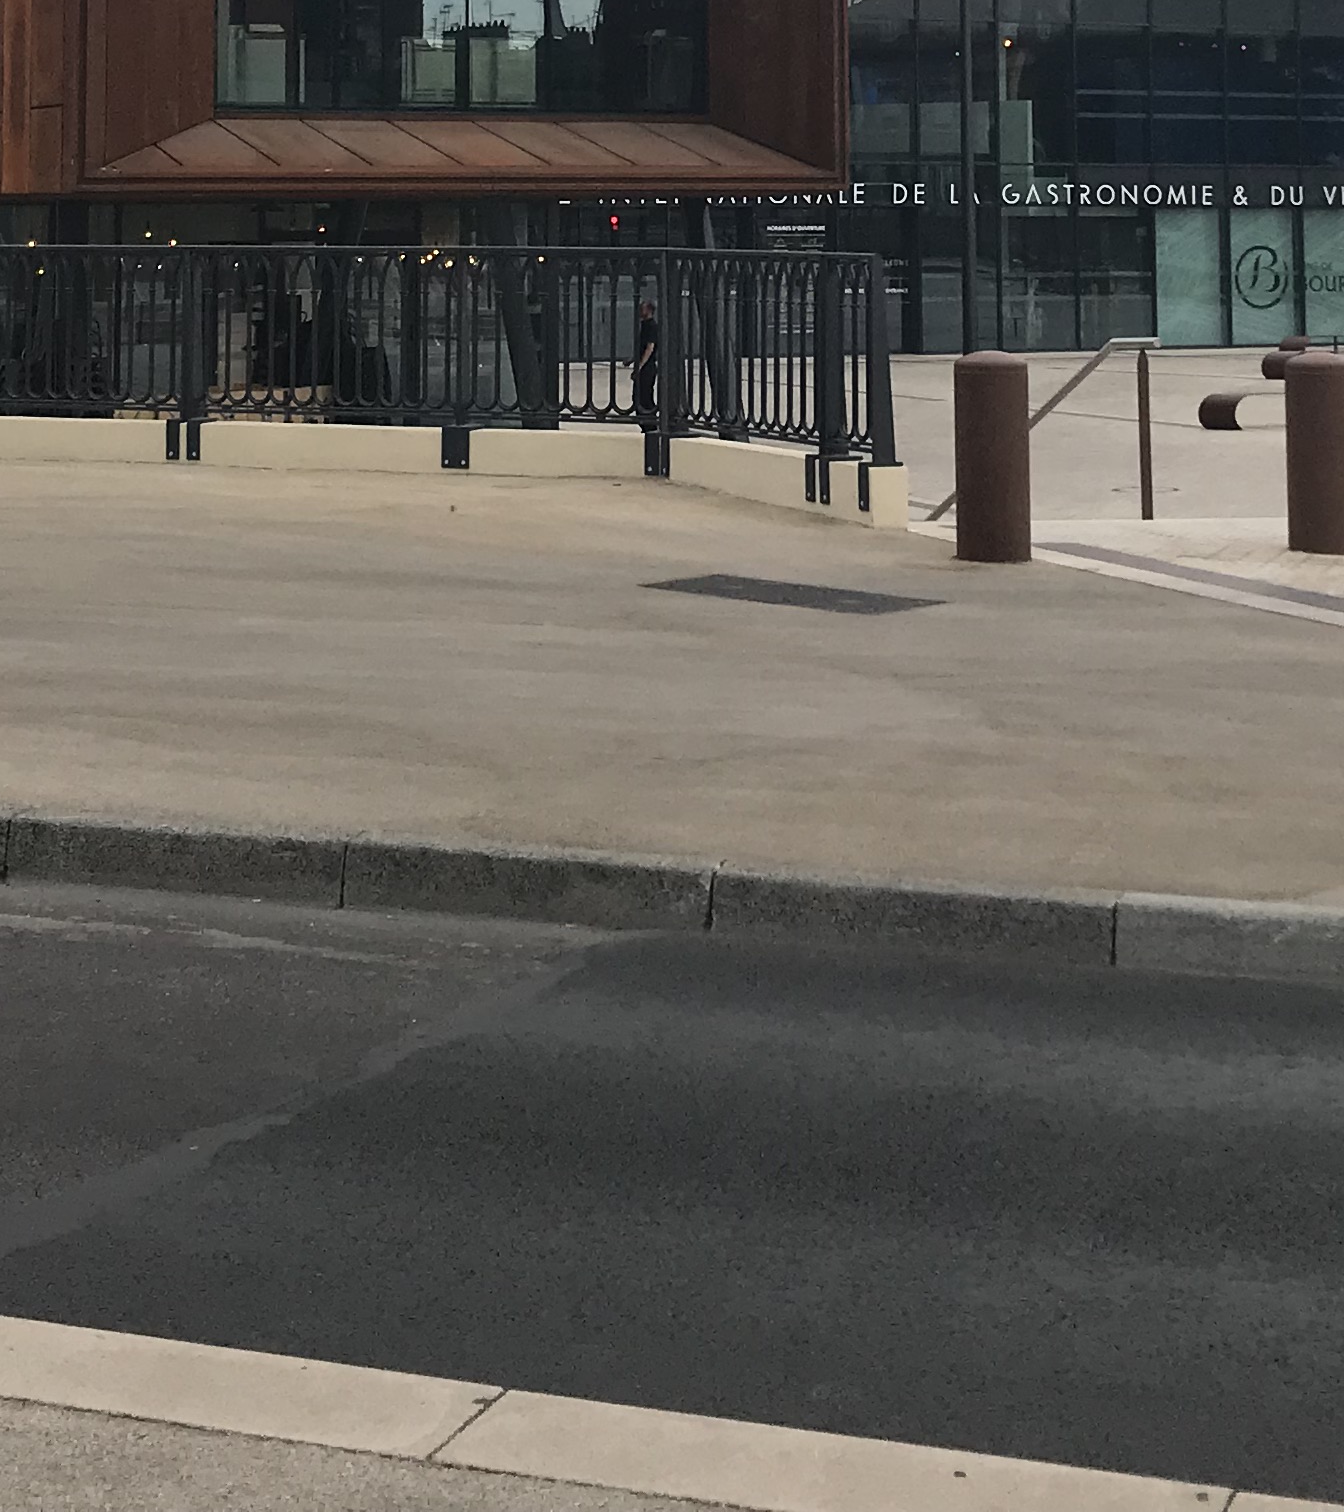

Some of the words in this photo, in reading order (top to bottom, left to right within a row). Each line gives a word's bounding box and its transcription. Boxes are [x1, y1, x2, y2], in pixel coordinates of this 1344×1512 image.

[892, 183, 925, 205] DE
[1001, 183, 1214, 206] GASTRONOMIE
[1232, 184, 1248, 206] &
[1270, 185, 1304, 206] DU
